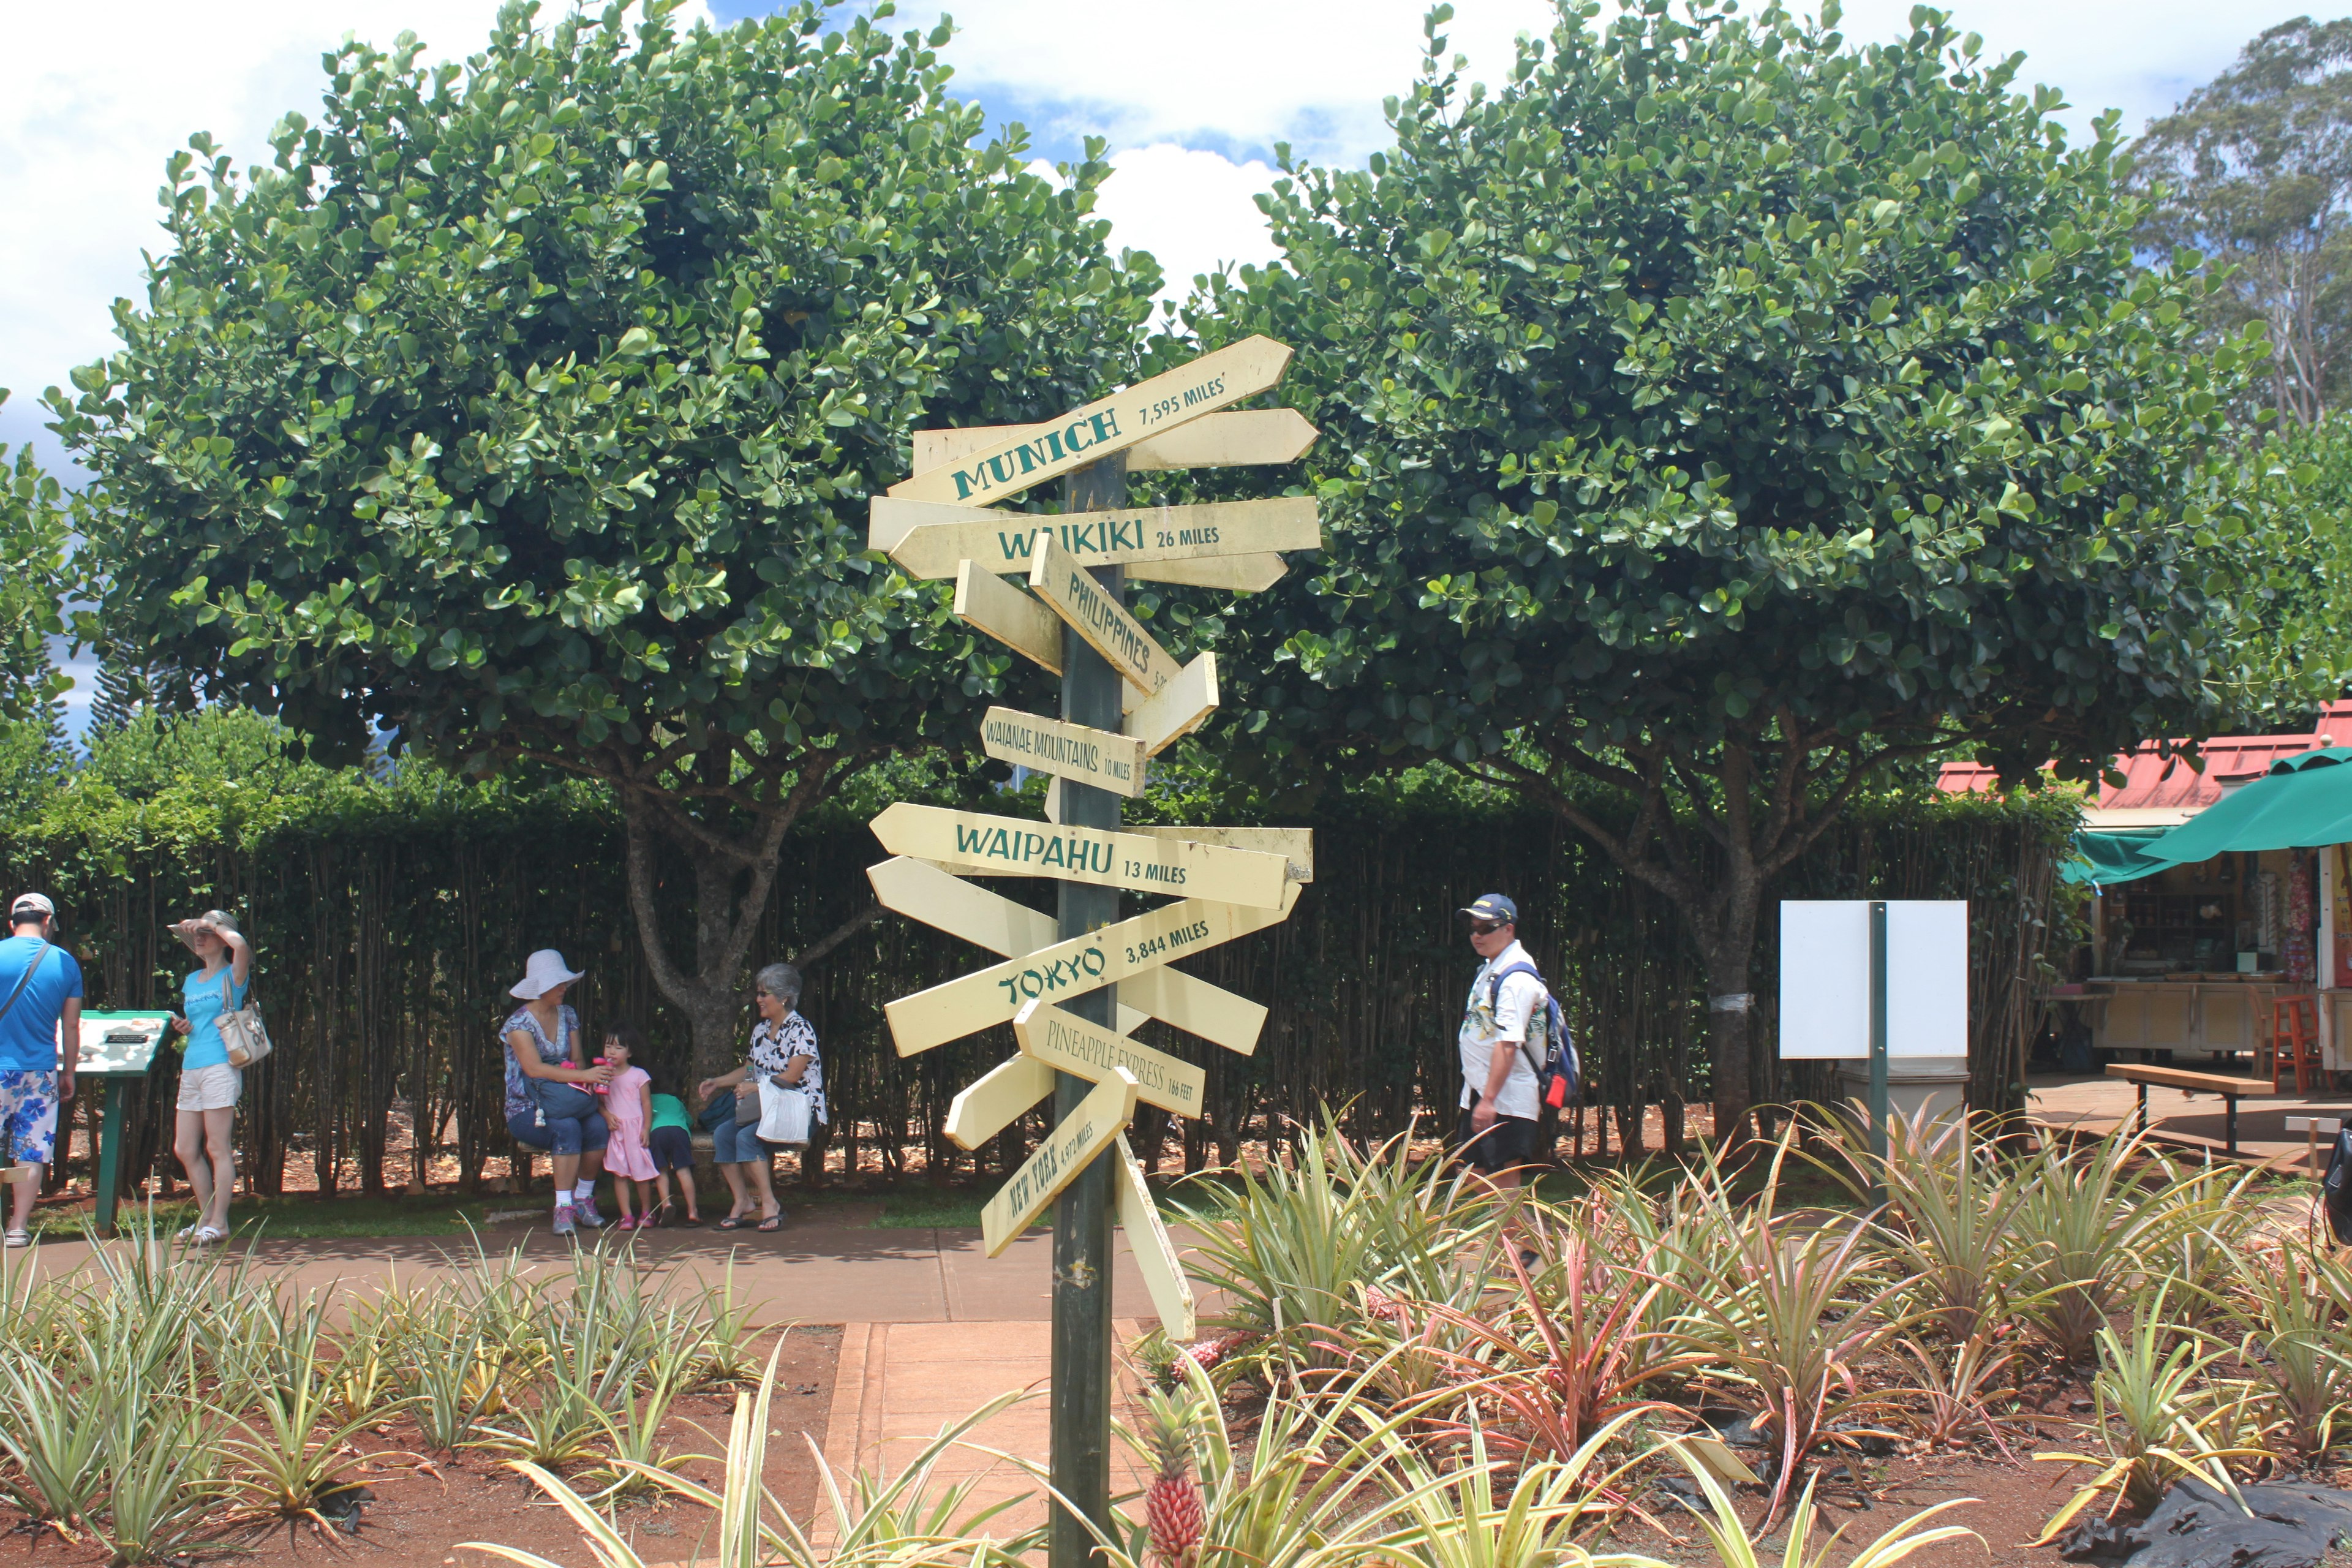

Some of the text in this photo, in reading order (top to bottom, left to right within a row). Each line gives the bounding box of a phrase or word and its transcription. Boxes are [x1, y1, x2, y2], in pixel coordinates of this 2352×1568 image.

[951, 378, 1224, 500] MUNICH 7,595 MILES
[998, 519, 1219, 560] WIKIKI 26 MILES
[1069, 571, 1150, 674] PHILIPPINES
[986, 719, 1130, 781] WAIANAE MOUNTAINS 10 MILES
[957, 824, 1186, 884] WAIPAHU 13 MILES
[998, 920, 1209, 1005] TOKYO 3,844 MILES
[1047, 1019, 1193, 1101] PINEAPPLE EXPRESS 166 FEET
[1009, 1121, 1093, 1218] NEW YORK 4,972 MILES
